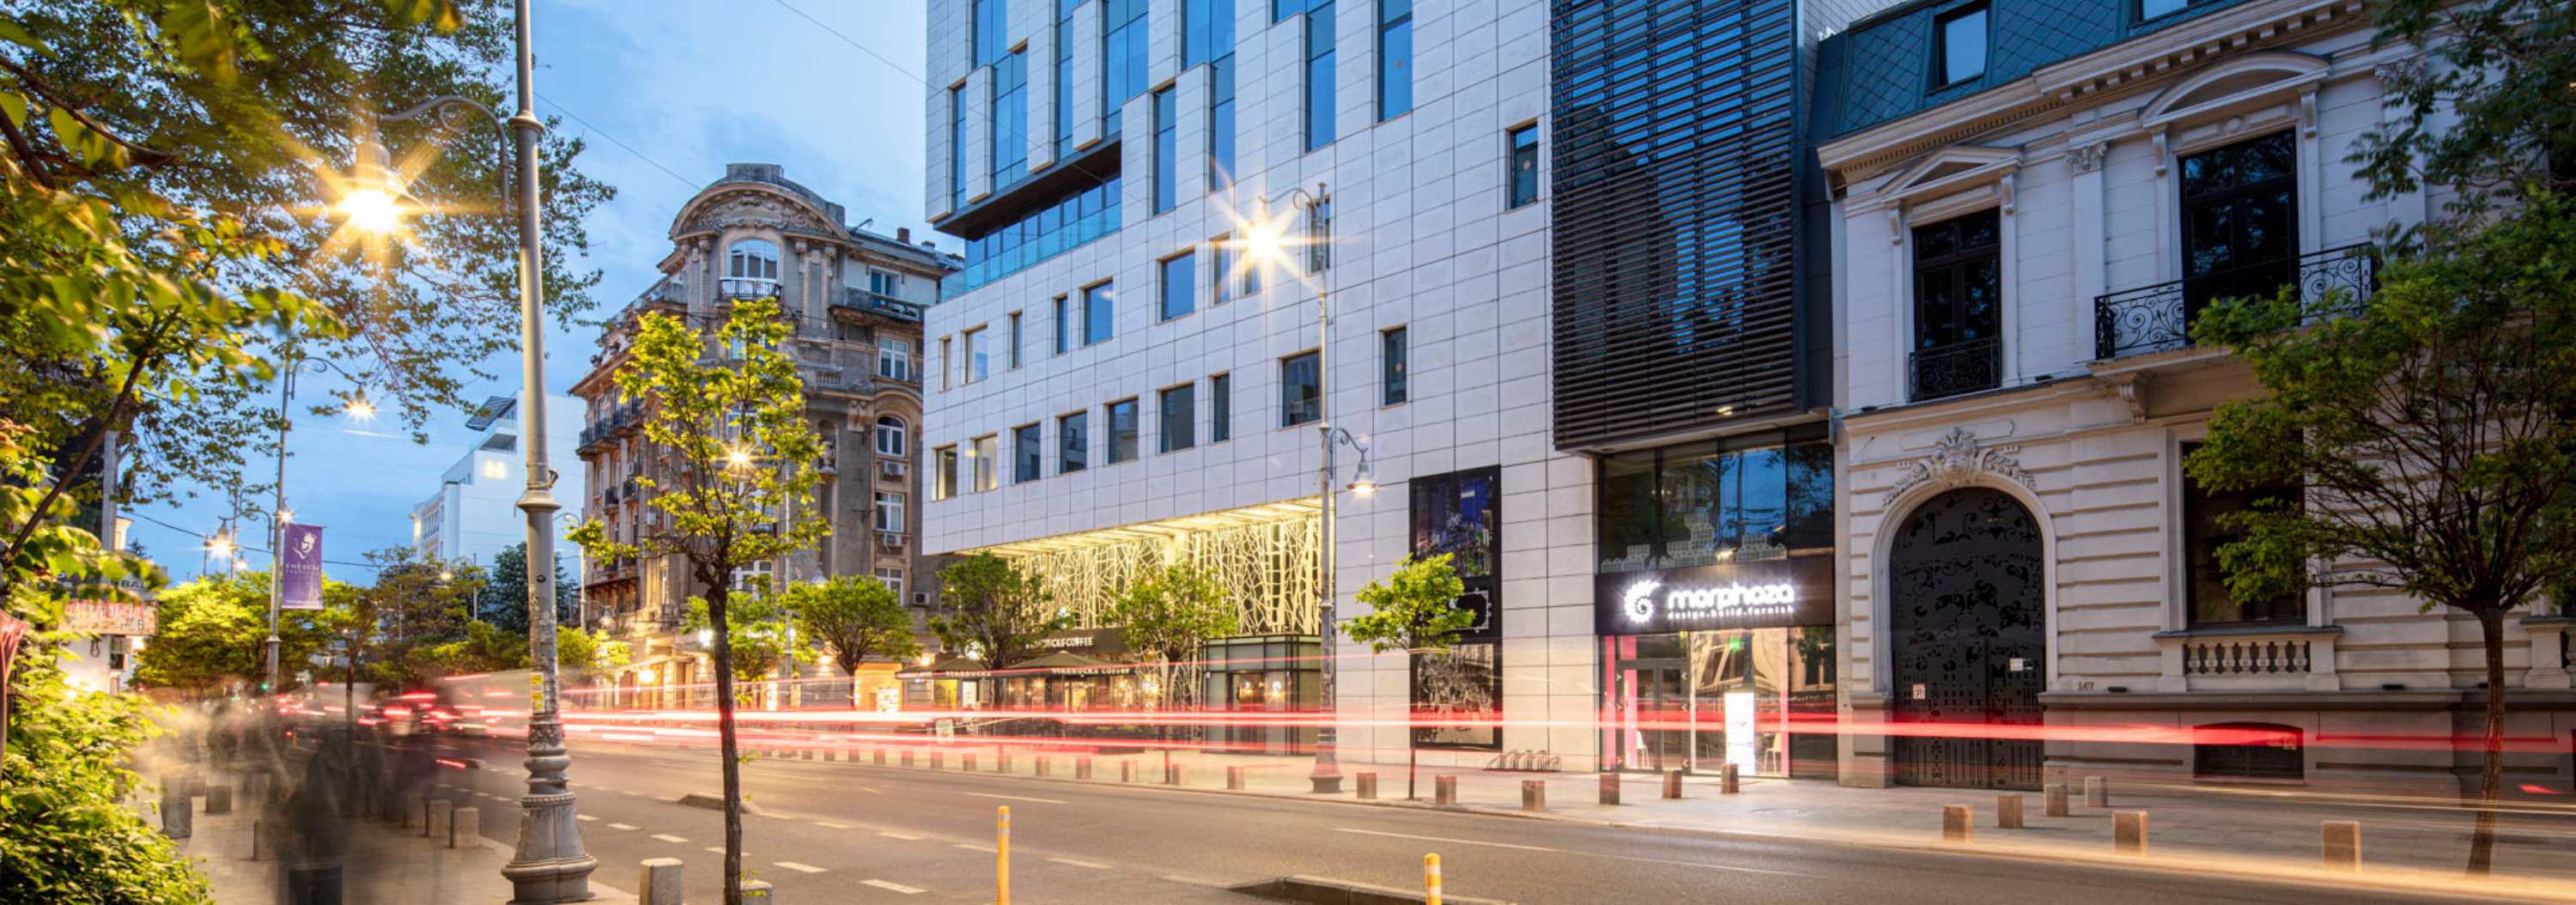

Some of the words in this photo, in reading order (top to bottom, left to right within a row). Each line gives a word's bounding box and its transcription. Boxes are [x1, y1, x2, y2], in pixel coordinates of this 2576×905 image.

[485, 461, 505, 478] H
[1668, 582, 1794, 610] morphoza
[120, 618, 145, 631] HUB
[1066, 637, 1093, 647] COFFEE
